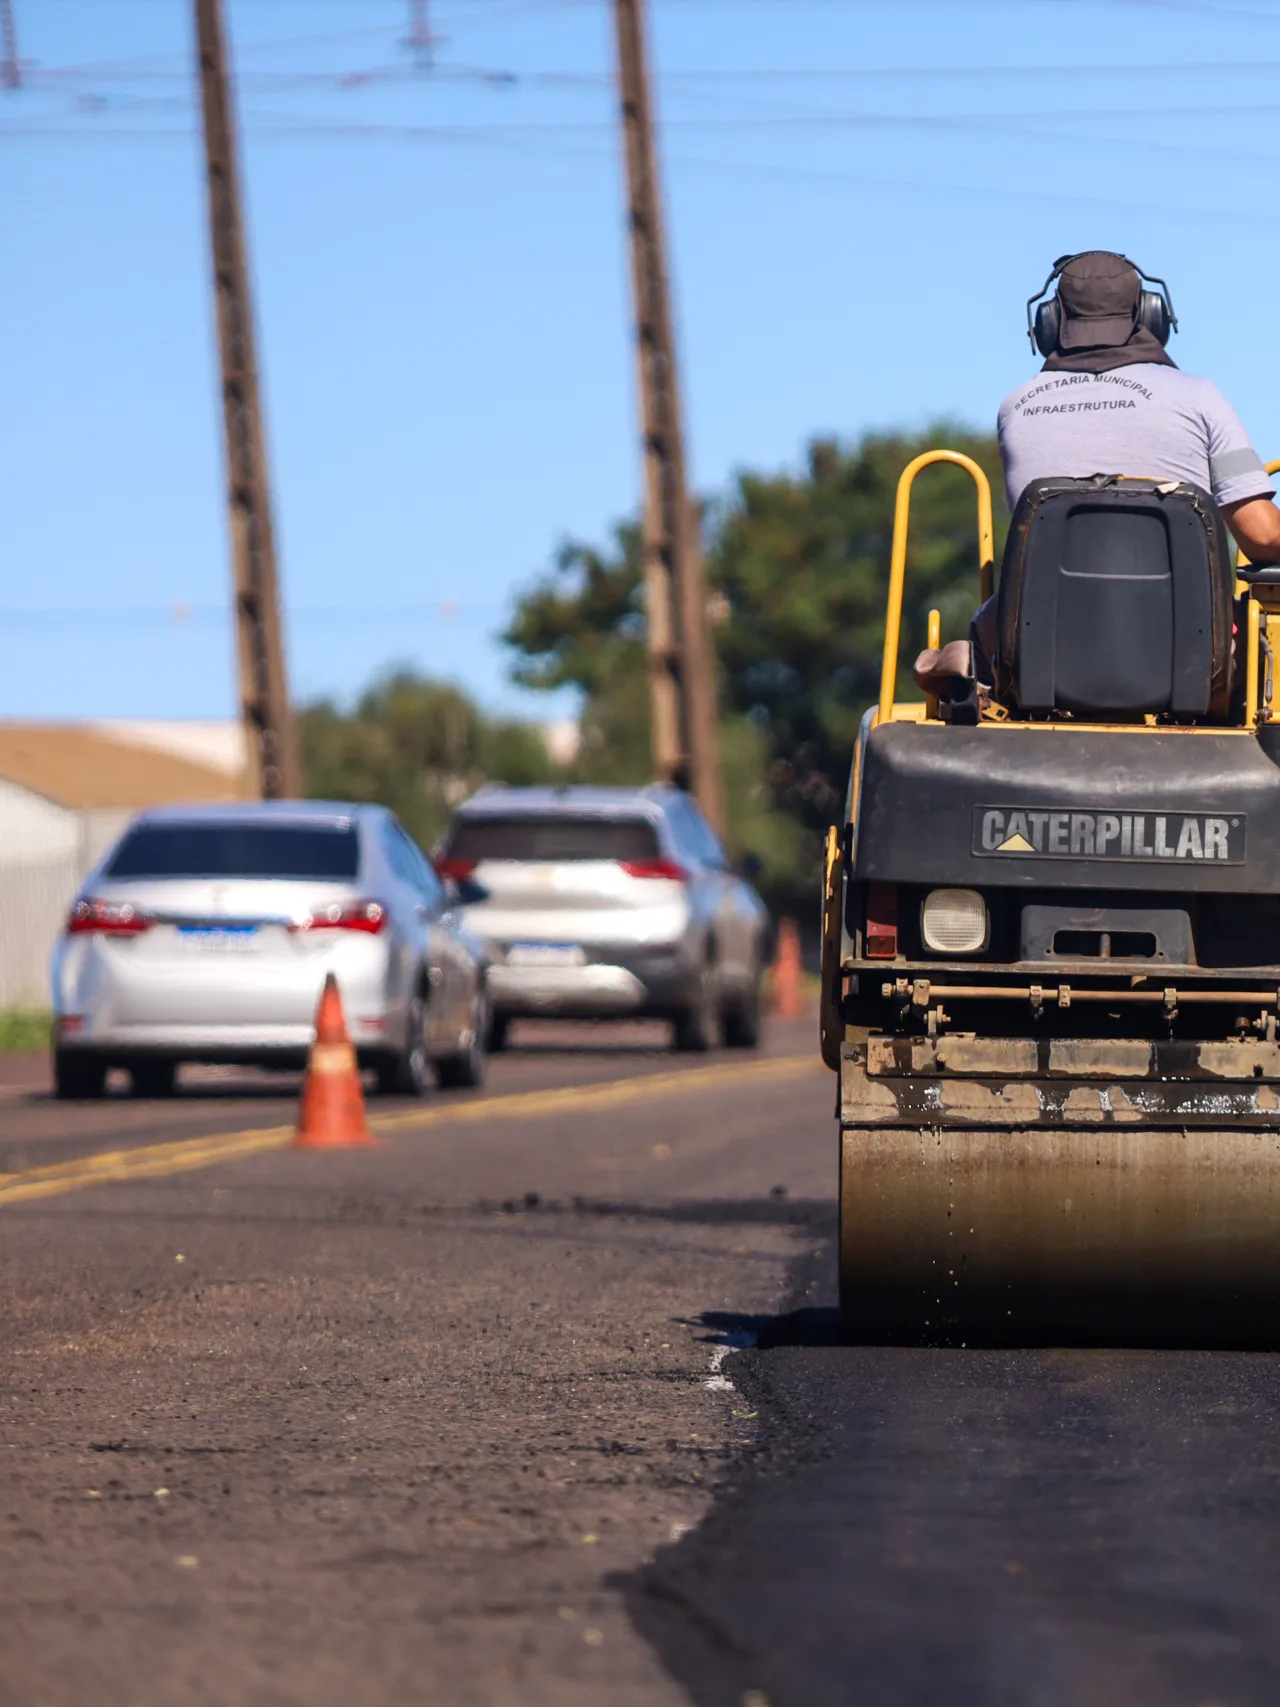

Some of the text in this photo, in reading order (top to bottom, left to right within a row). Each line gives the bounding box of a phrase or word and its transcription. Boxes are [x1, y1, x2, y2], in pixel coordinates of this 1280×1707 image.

[1014, 374, 1153, 410] SECRETARIA MUNICIPAL
[1023, 399, 1136, 417] INFRAESTRUTURA
[982, 810, 1229, 859] CATERPILLAR
